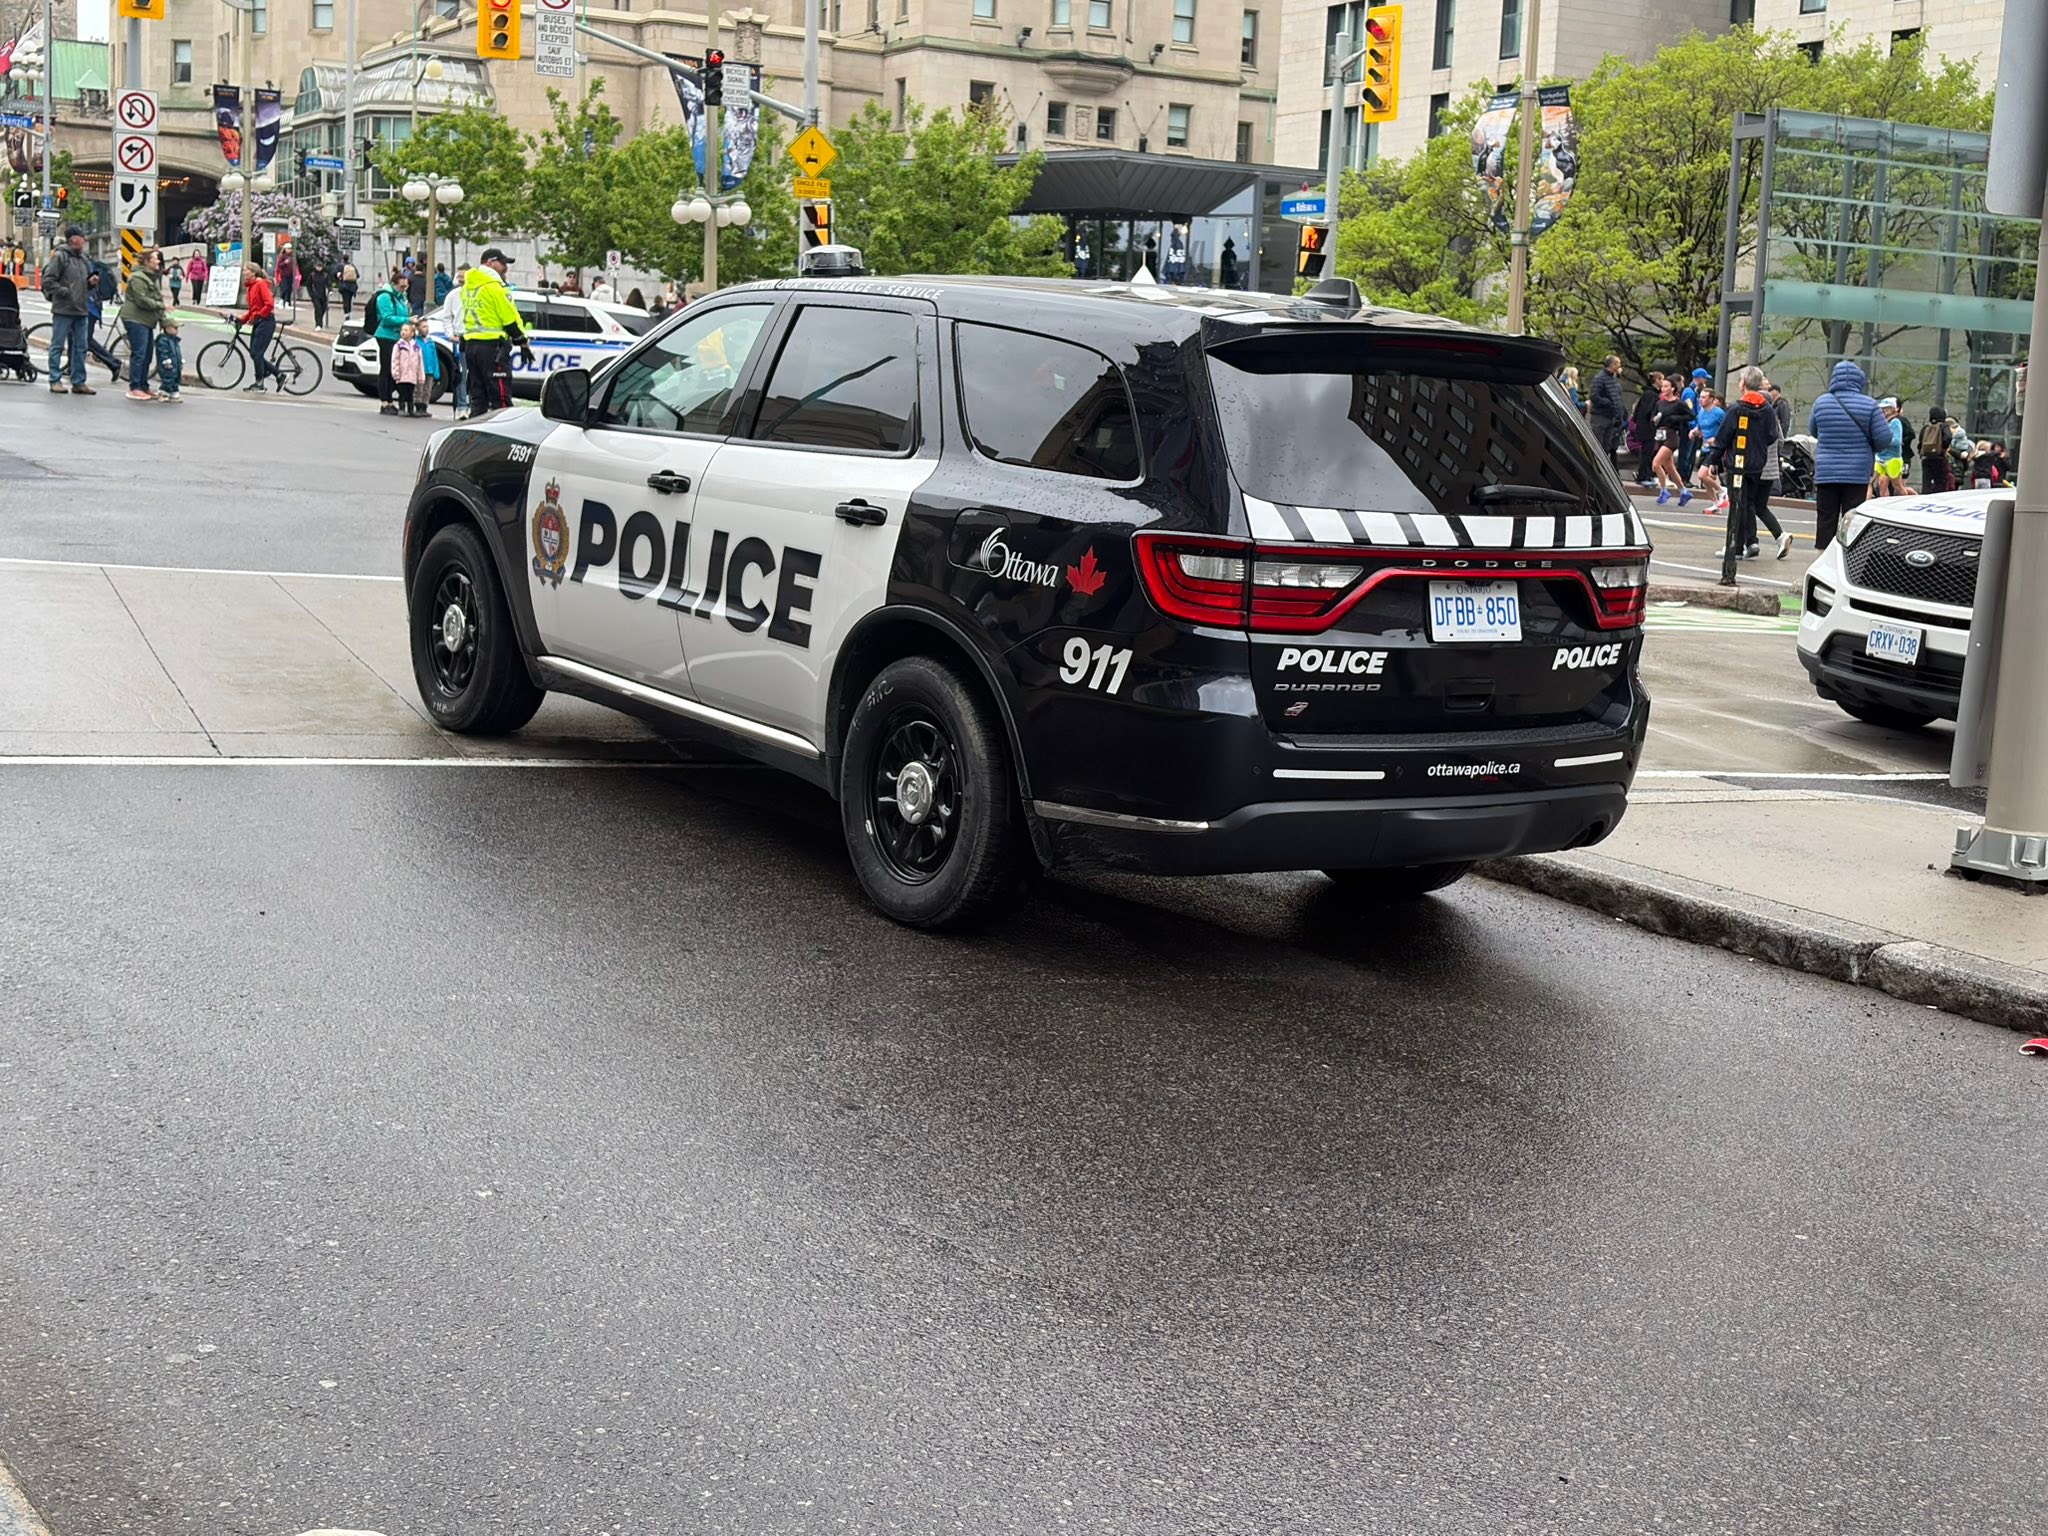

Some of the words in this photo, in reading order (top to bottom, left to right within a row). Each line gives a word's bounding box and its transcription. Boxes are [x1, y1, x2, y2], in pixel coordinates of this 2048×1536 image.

[543, 14, 567, 25] BUSES
[538, 24, 548, 33] AND
[549, 25, 572, 35] BICYCLES
[541, 33, 569, 44] EXCEPTED
[547, 46, 561, 55] SAUF
[538, 55, 563, 65] AUTOBUS
[564, 57, 571, 66] ET
[537, 64, 572, 75] BICYCLETTES
[725, 67, 748, 77] BICYCLE
[814, 281, 875, 293] COURAGE
[884, 285, 944, 300] SERVICE
[511, 351, 581, 373] OLICE
[507, 444, 533, 463] 7591
[980, 527, 1059, 587] Ottawa
[1422, 559, 1552, 568] DODGE
[570, 499, 822, 649] POLICE
[1456, 584, 1491, 595] ONTARIO
[1276, 648, 1389, 674] POLICE
[1552, 643, 1622, 670] POLICE
[1059, 636, 1133, 695] 911
[1273, 683, 1382, 692] DURANGO
[1427, 761, 1520, 778] ottawapolice.ca
